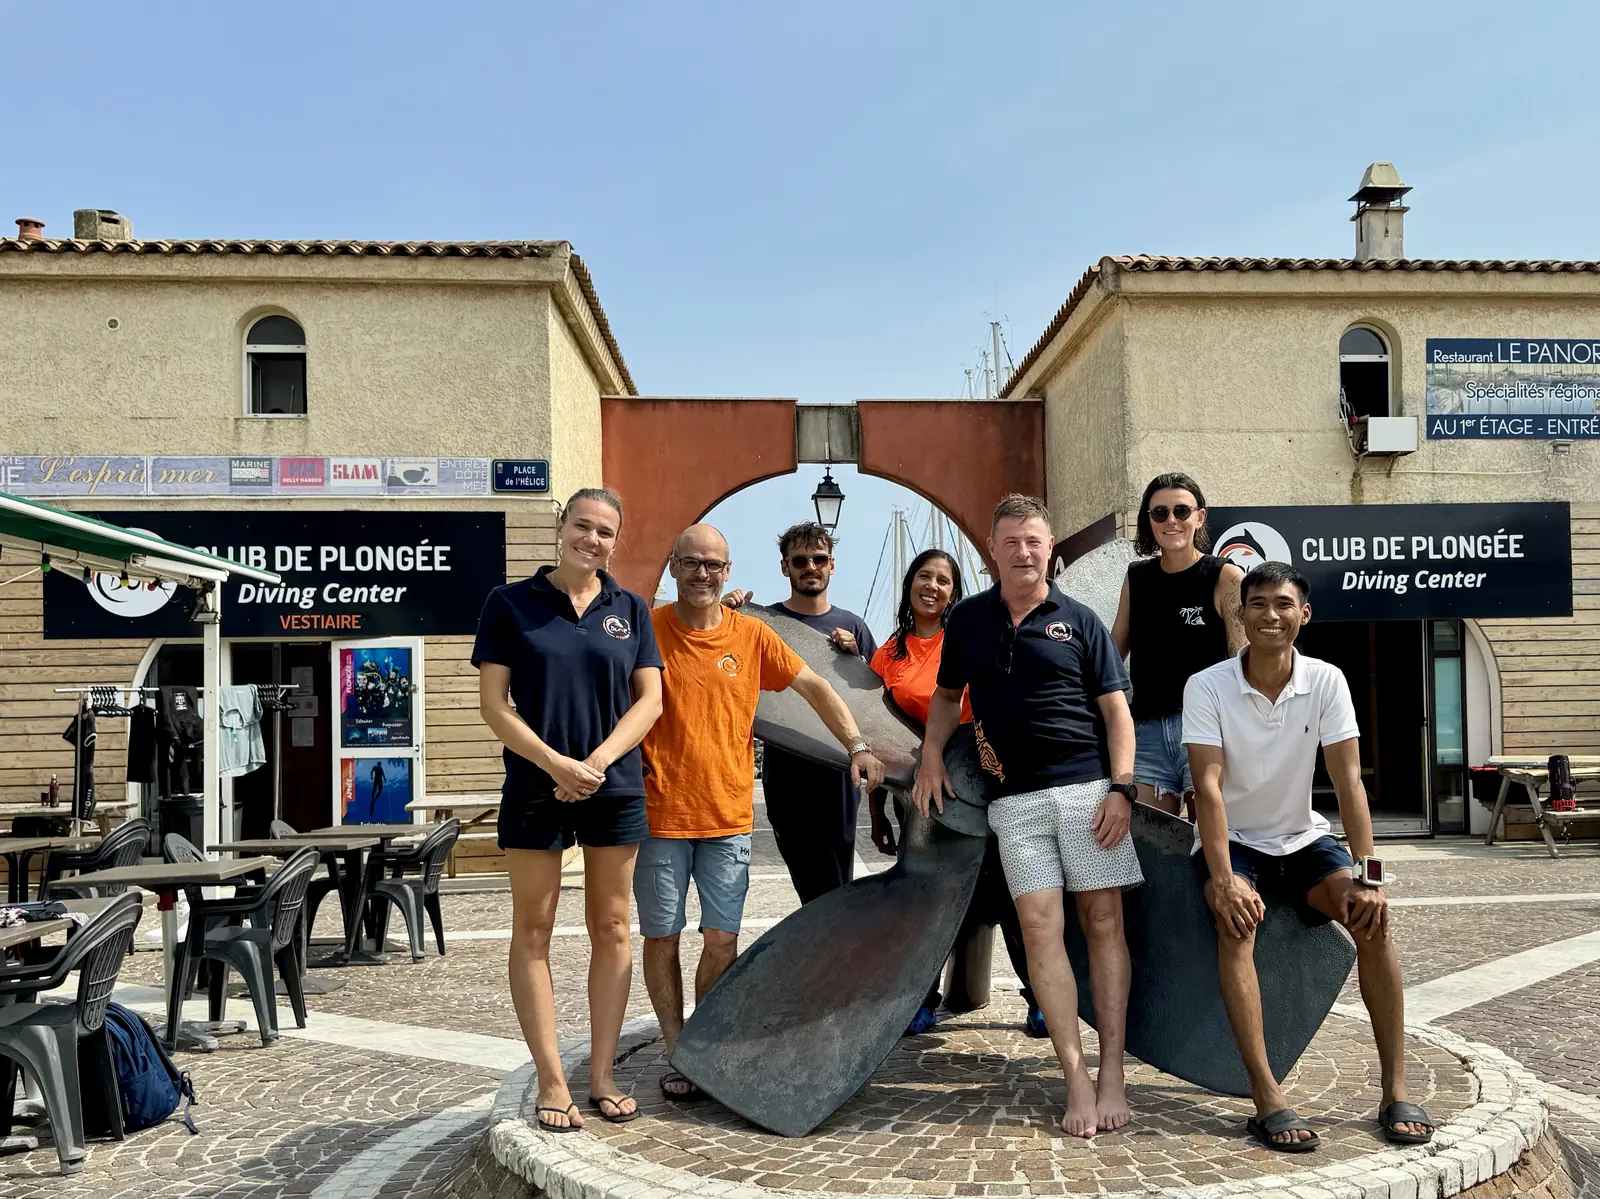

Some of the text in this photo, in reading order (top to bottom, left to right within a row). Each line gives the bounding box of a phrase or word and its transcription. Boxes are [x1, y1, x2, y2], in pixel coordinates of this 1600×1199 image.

[1433, 350, 1494, 363] Restaurant
[1497, 343, 1521, 363] LE
[1466, 381, 1545, 402] Spécialités
[1432, 419, 1457, 435] AU
[1460, 419, 1476, 435] 1er
[1480, 416, 1534, 435] ÉTAGE
[231, 460, 270, 469] MARINE
[333, 464, 379, 480] SLAM
[513, 466, 536, 475] PLACE
[158, 469, 220, 483] mer
[505, 477, 514, 486] de
[1302, 528, 1524, 562] CLUB DE PLONGÉE
[274, 545, 313, 572] DE
[320, 538, 451, 572] PLONGÉE
[1341, 569, 1487, 595] Diving Center
[237, 582, 407, 609] Diving Center
[280, 614, 361, 629] VESTIAIRE
